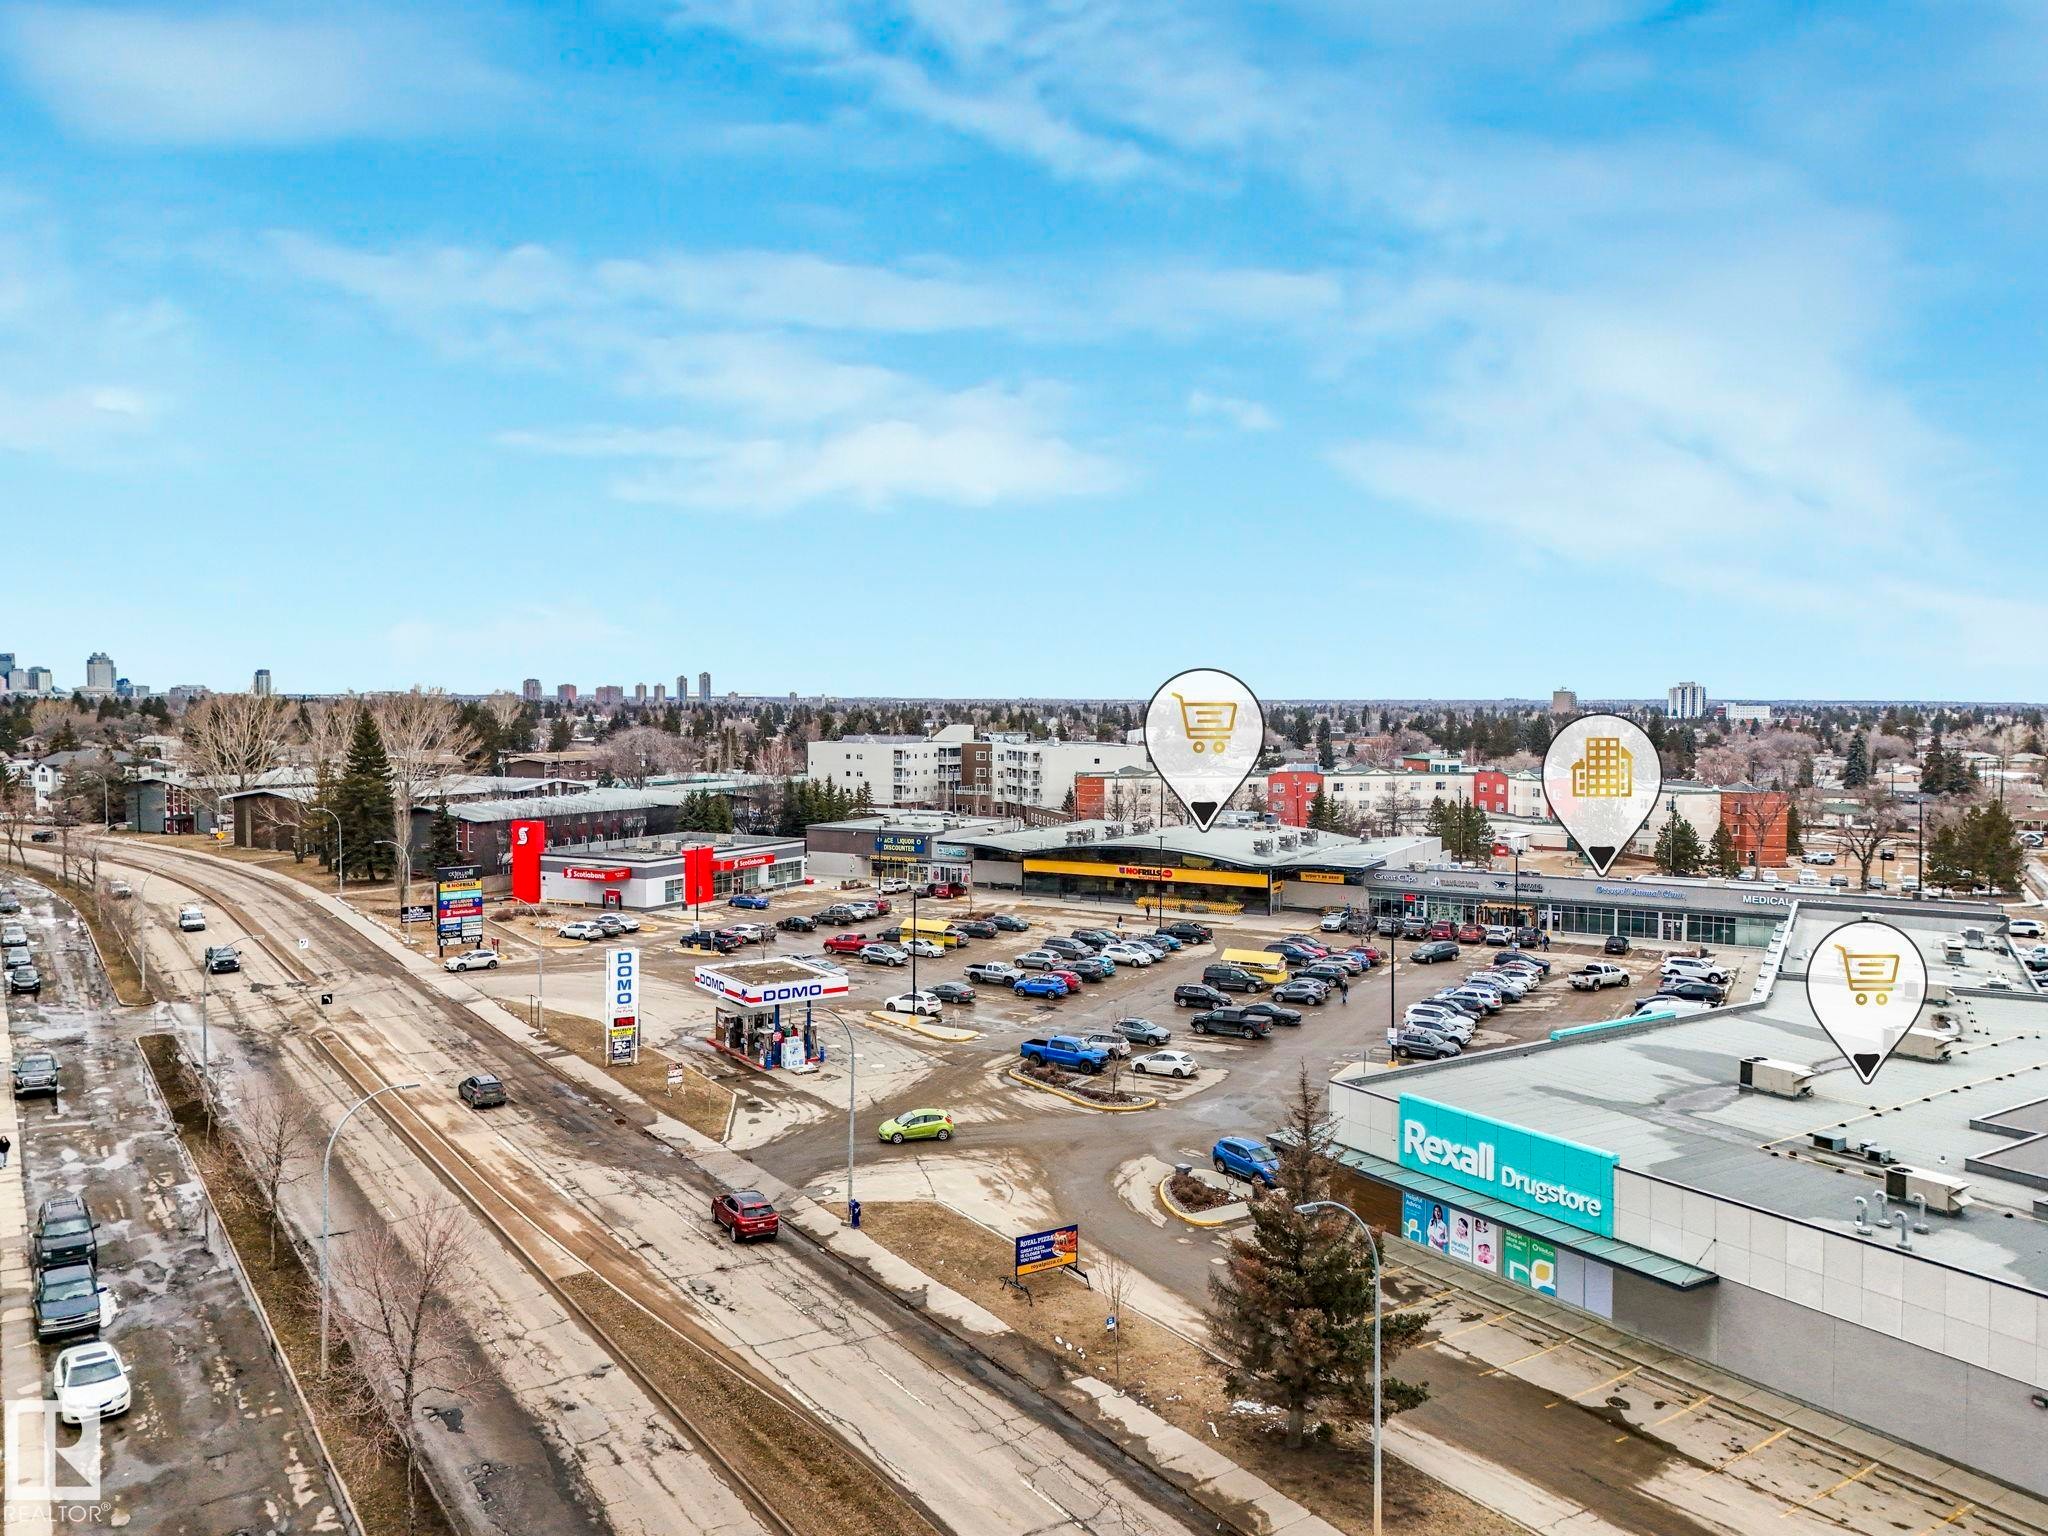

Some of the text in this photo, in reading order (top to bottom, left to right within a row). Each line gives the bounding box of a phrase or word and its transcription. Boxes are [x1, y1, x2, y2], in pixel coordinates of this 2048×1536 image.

[740, 858, 766, 866] Scotiabank
[574, 870, 605, 879] Scotiabank
[1374, 872, 1418, 882] Great Clips
[1742, 895, 1792, 906] MEDICAL
[617, 952, 632, 1004] DOMO
[700, 974, 724, 992] DOMO
[763, 984, 822, 1002] DOMO
[1404, 1119, 1601, 1217] Rexall Drugstore
[1020, 1234, 1054, 1247] ROYAL PIZZA
[1030, 1258, 1062, 1270] royalpizza.ca
